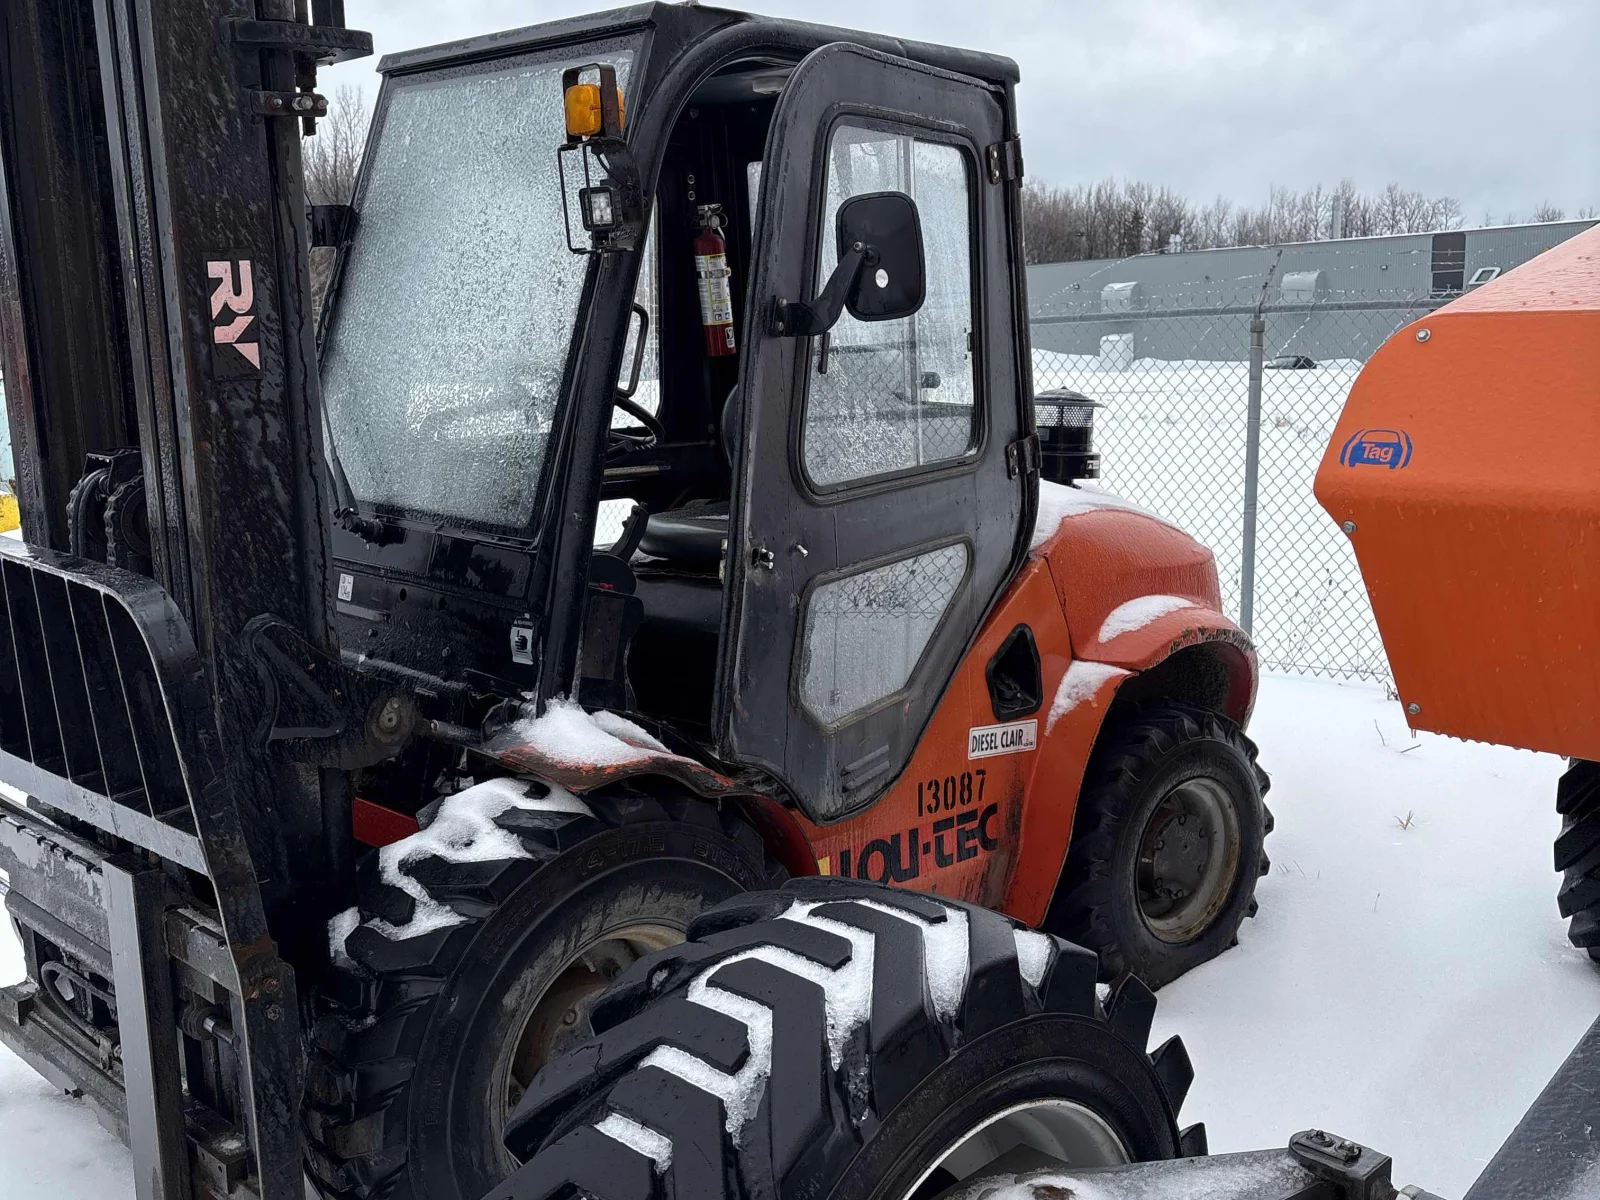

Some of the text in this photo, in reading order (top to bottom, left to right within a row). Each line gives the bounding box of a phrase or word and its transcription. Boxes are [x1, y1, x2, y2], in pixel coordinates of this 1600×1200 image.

[1362, 443, 1393, 462] Tag
[971, 732, 998, 753] DIESEL
[1000, 729, 1024, 748] CLAIR
[918, 769, 987, 817] 13087
[575, 834, 666, 876] 14-17.5
